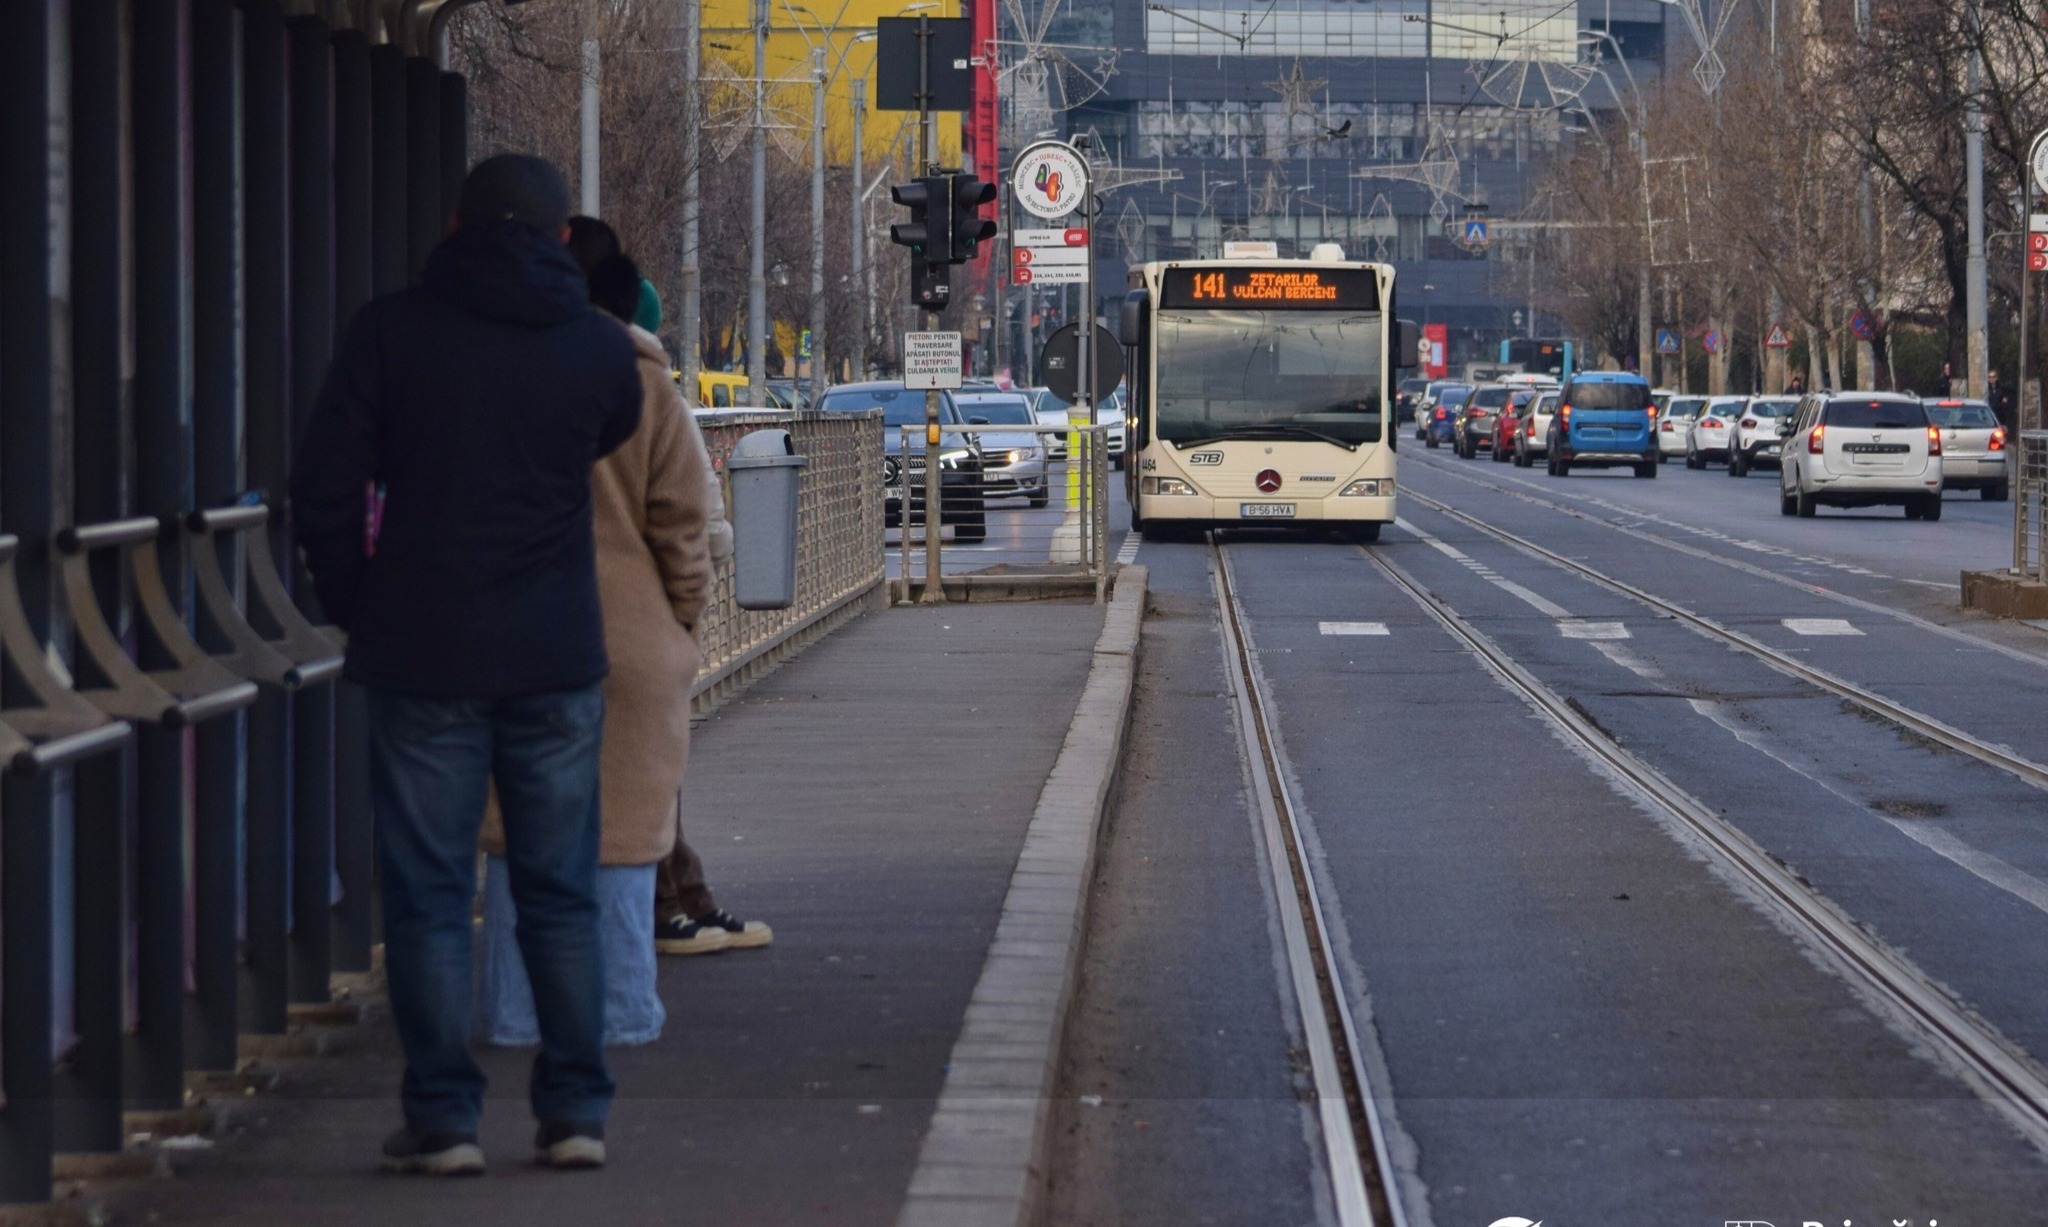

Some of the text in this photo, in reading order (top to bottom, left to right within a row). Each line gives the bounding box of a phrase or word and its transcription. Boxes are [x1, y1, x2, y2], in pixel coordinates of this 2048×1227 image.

[1019, 159, 1036, 190] MUNCESC
[1039, 153, 1063, 161] IUBESC
[1030, 199, 1059, 213] SECTORUL
[1060, 192, 1076, 210] PATRU
[1193, 273, 1225, 298] 141
[1250, 273, 1319, 287] ZETARILOR
[1233, 286, 1336, 299] VULCAN BERCENI
[1190, 453, 1221, 463] STB
[1249, 505, 1292, 515] B 56 HVA
